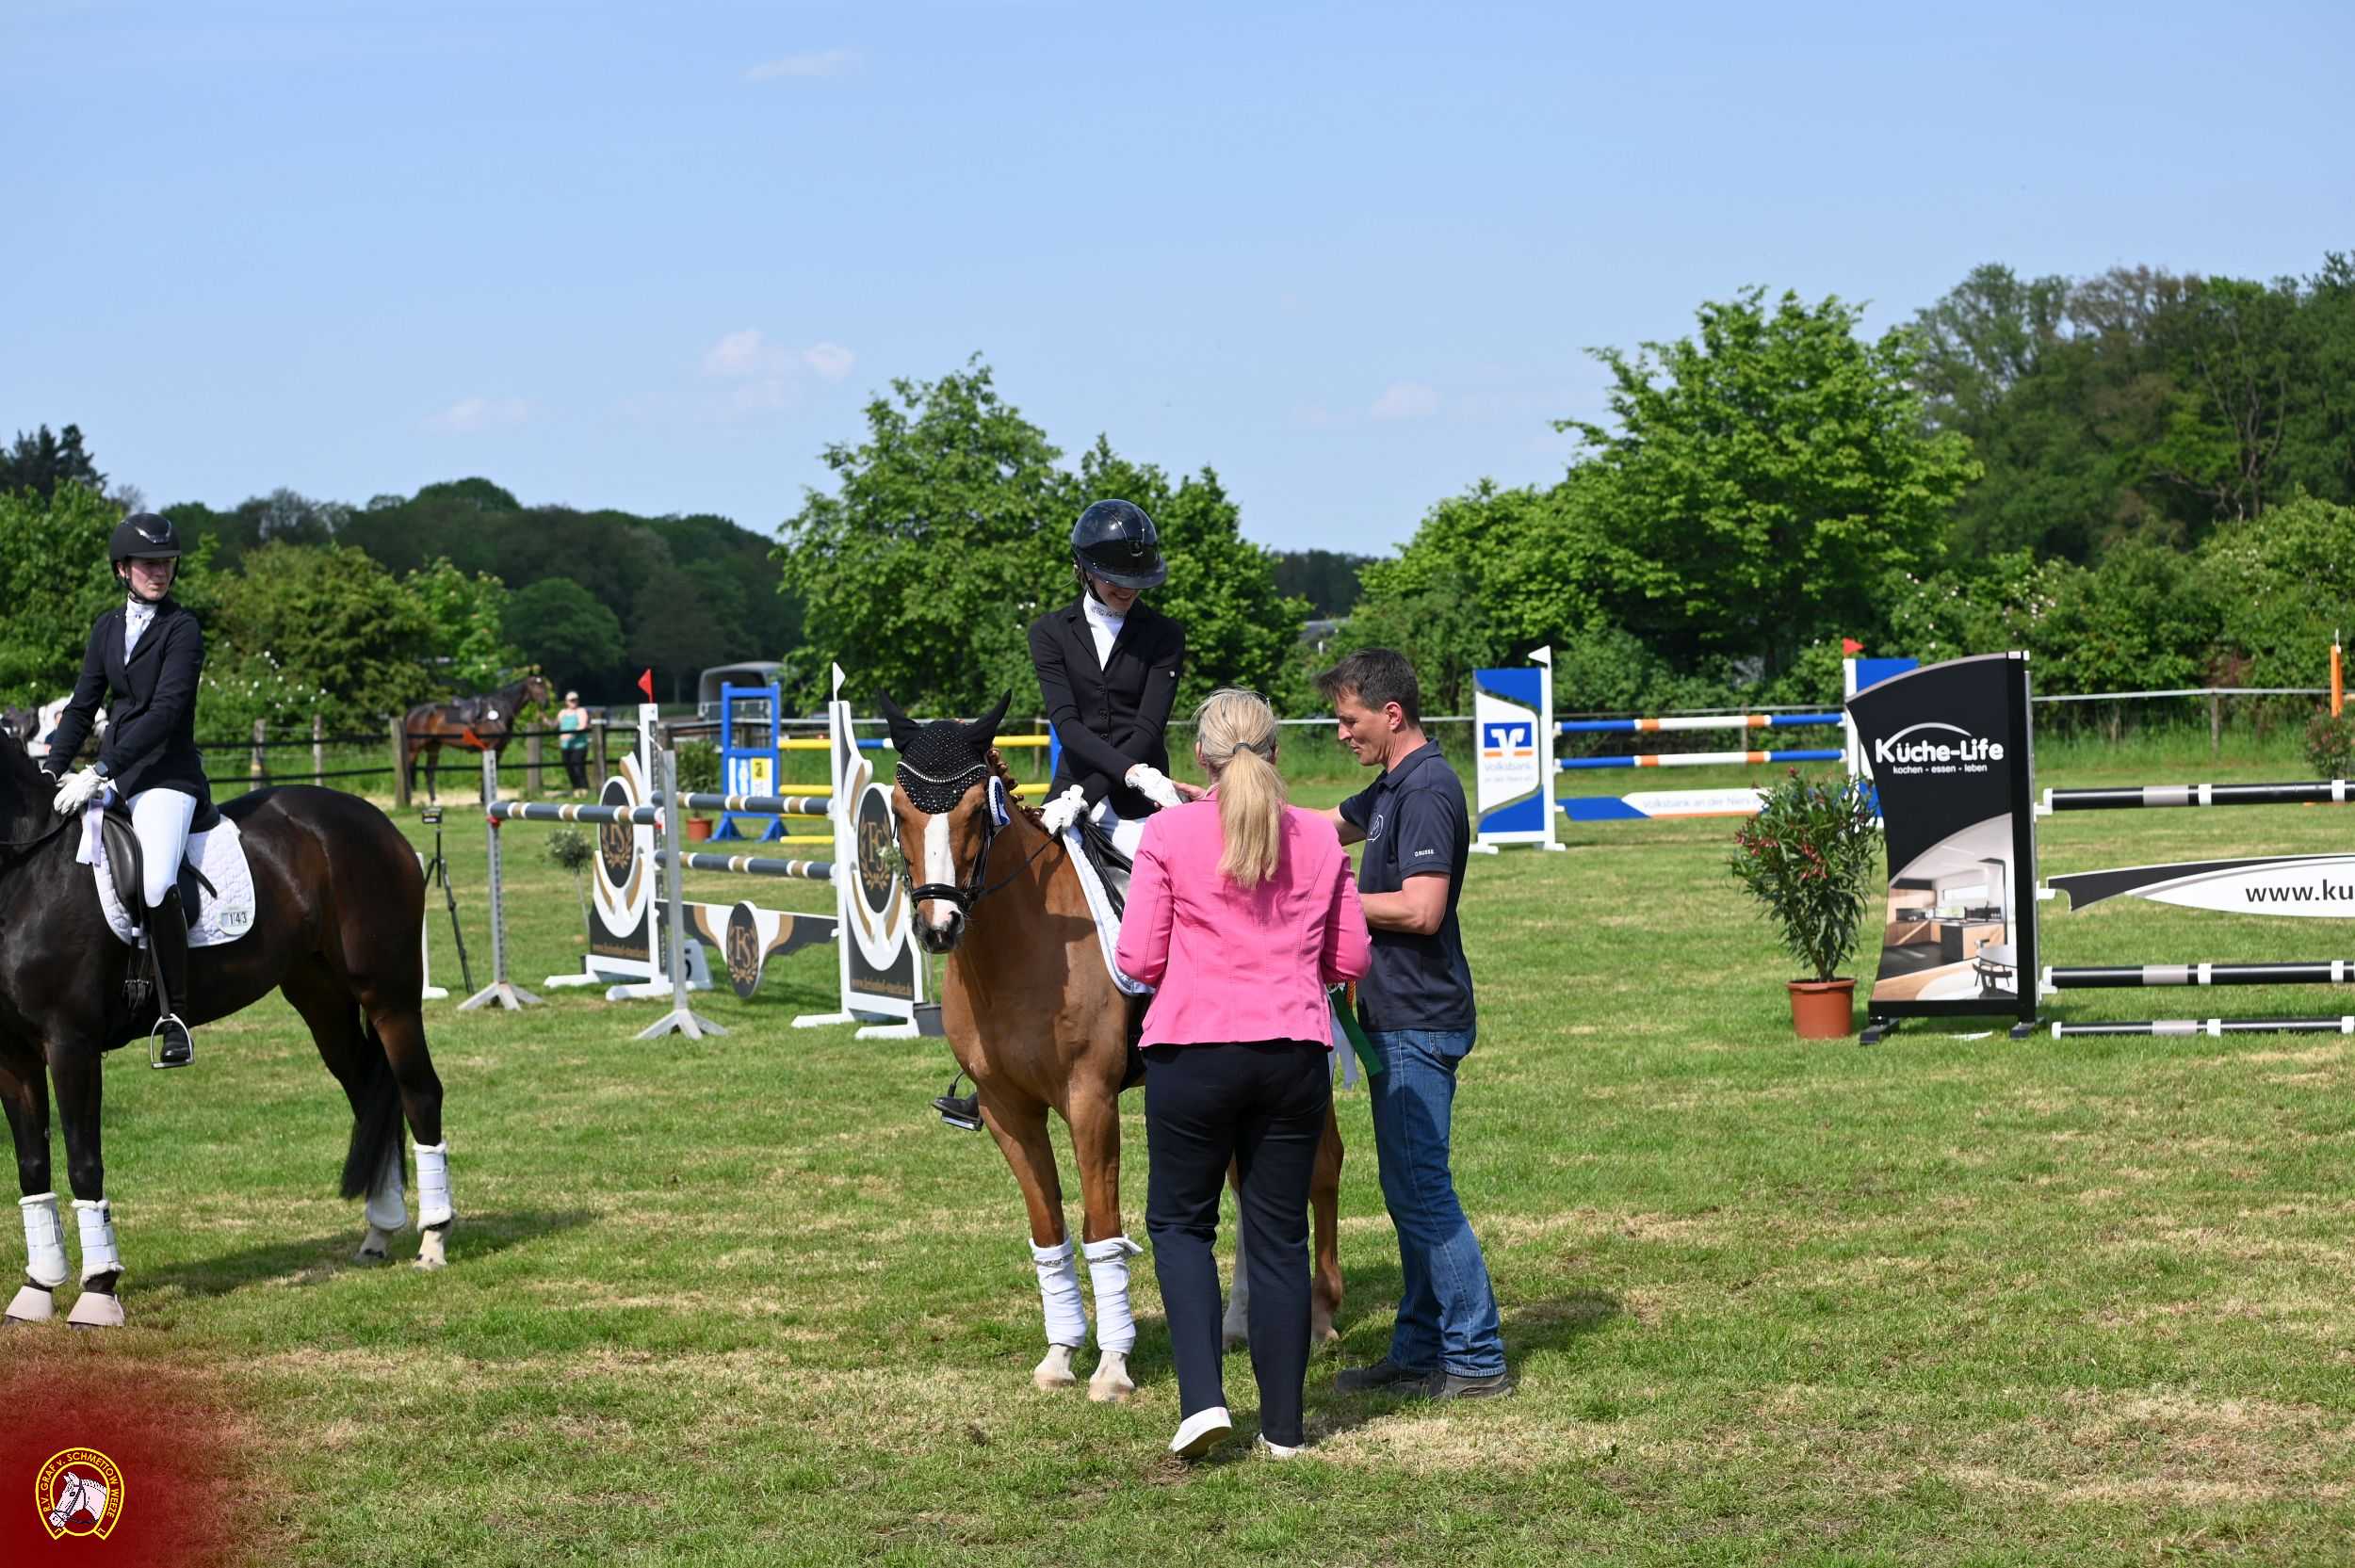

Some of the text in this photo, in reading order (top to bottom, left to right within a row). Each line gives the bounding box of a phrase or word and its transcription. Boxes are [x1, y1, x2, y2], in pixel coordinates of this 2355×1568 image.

[1875, 737, 2004, 764] Küche-Life
[1892, 765, 1924, 775] kochen
[1931, 765, 1957, 774] essen
[1964, 763, 1988, 773] leben
[2245, 878, 2354, 902] www.ku
